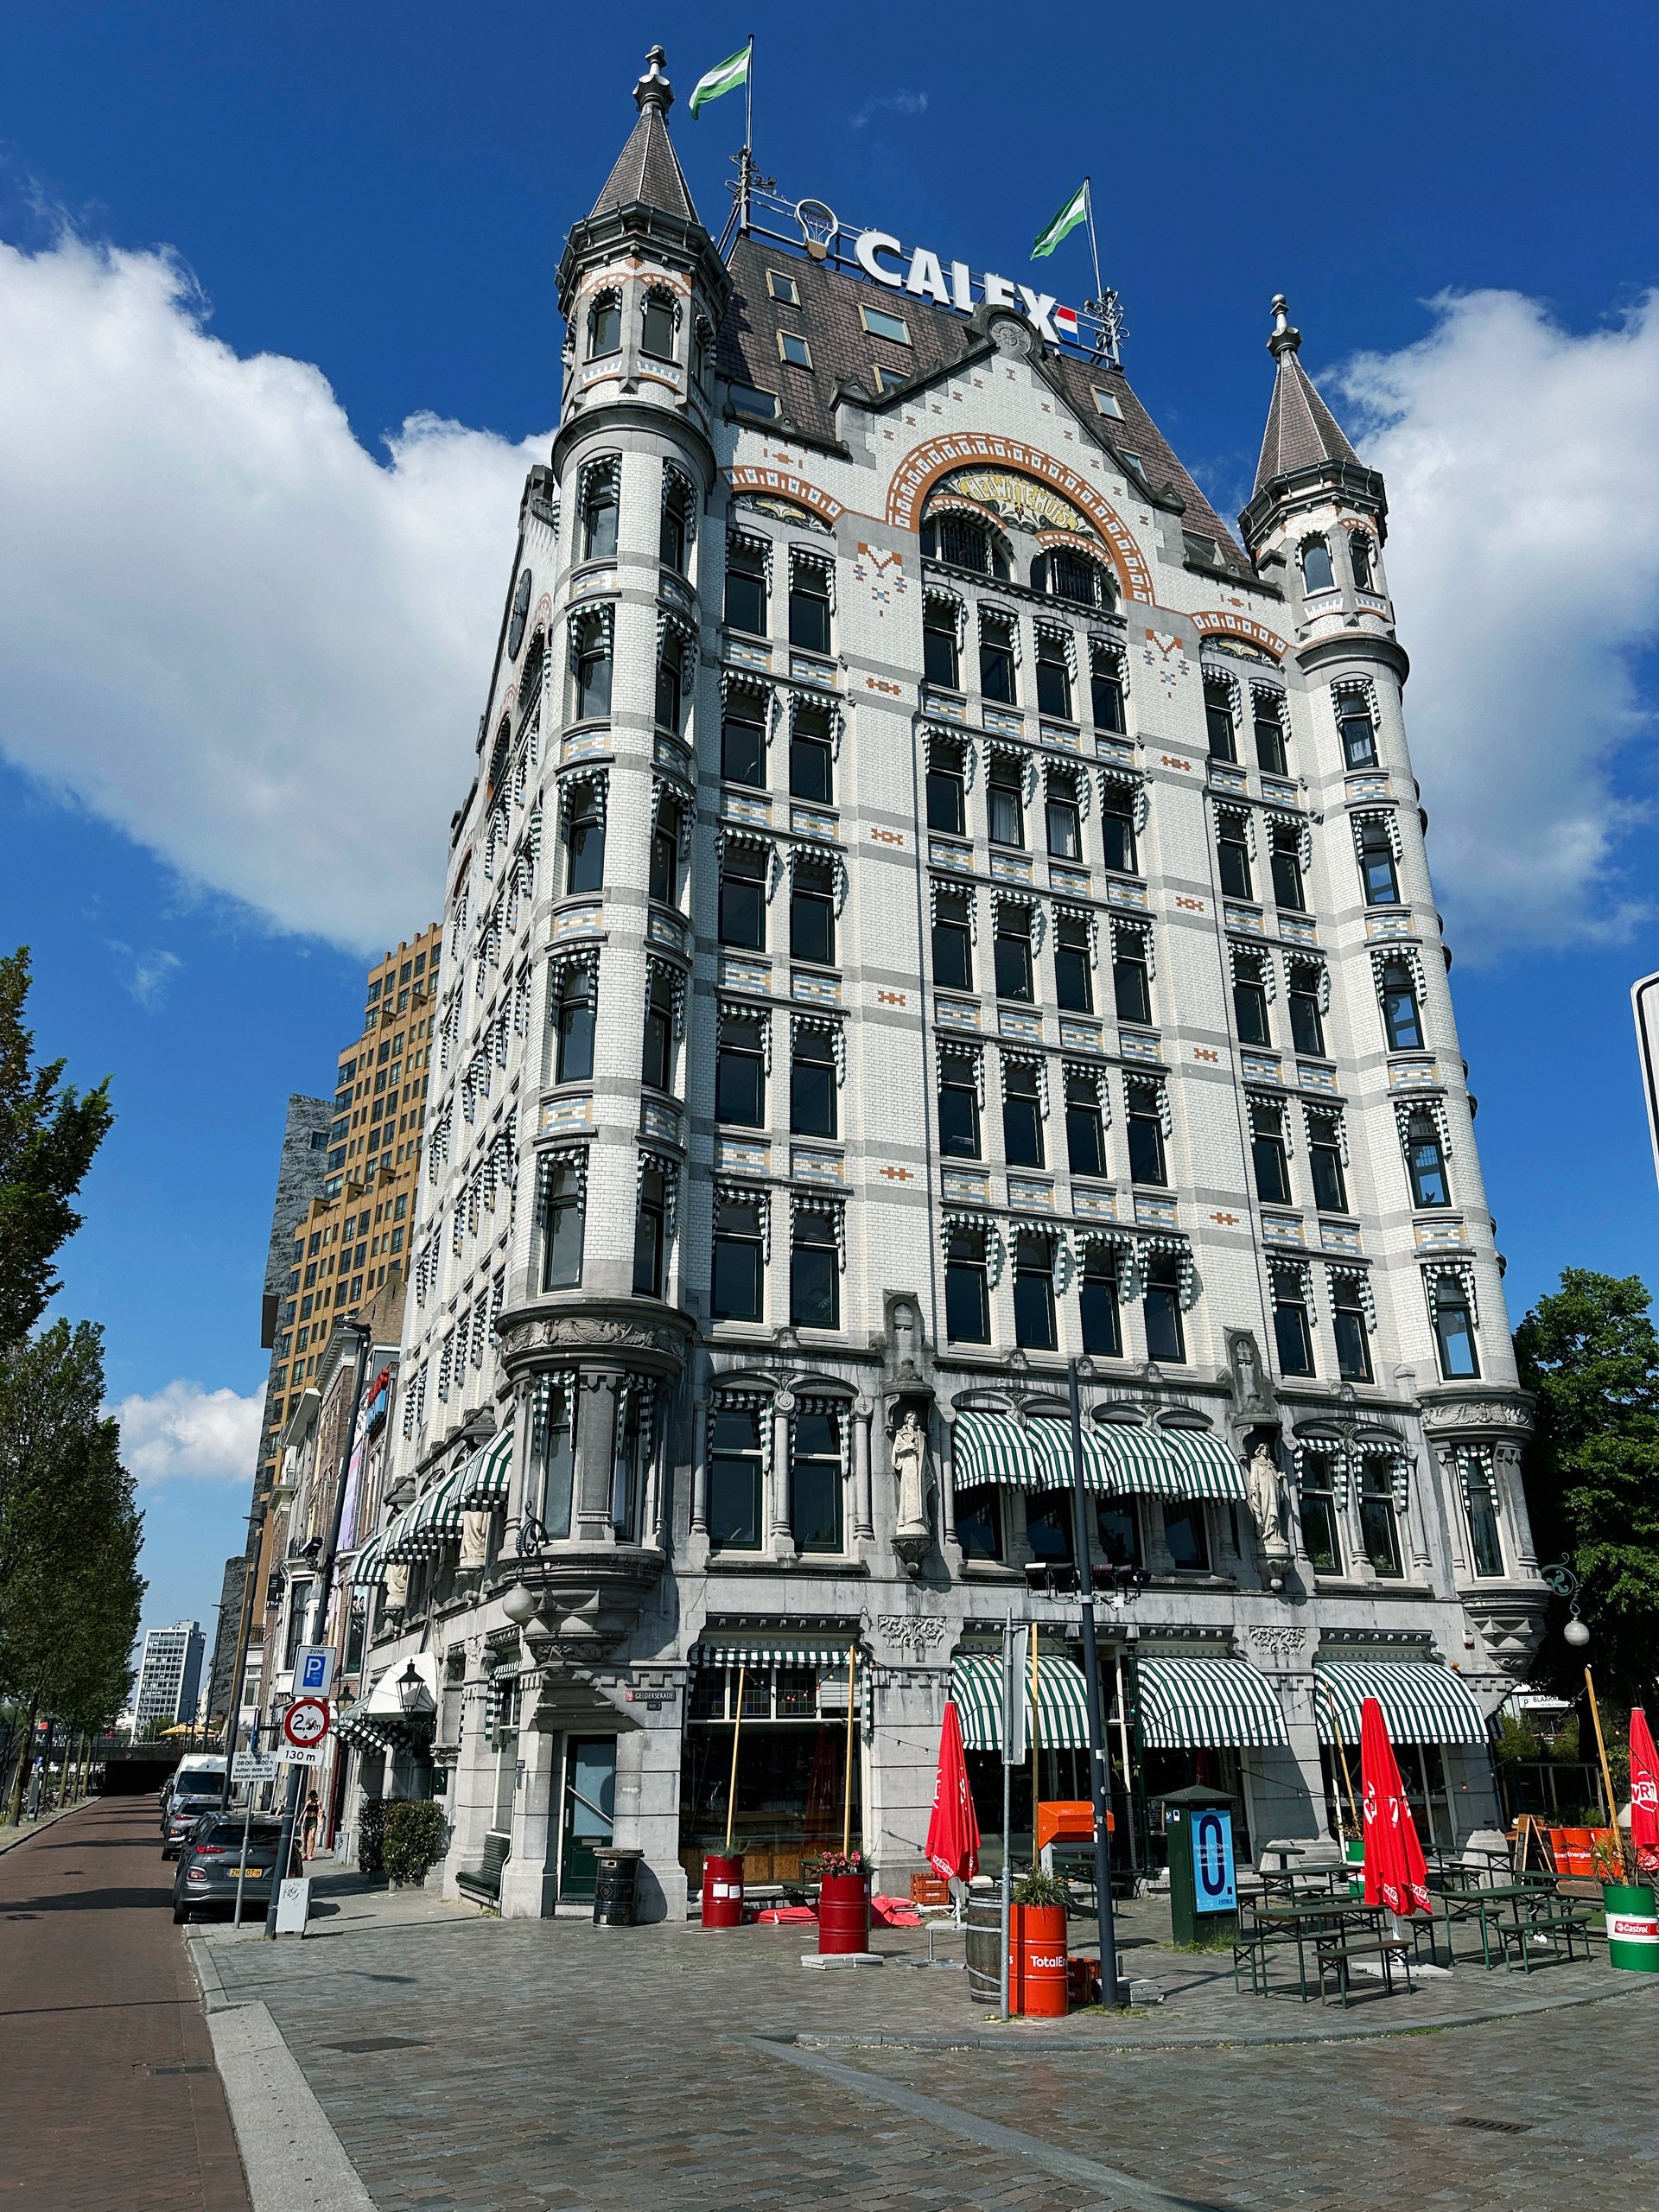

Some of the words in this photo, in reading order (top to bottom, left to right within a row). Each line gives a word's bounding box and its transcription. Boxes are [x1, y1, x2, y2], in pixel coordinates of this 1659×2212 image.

[855, 232, 1060, 344] CALEX
[306, 1657, 322, 1679] P
[285, 1750, 304, 1760] 130
[306, 1753, 316, 1762] m
[933, 1854, 955, 1877] MARTINI
[1624, 1924, 1649, 1935] Castrol
